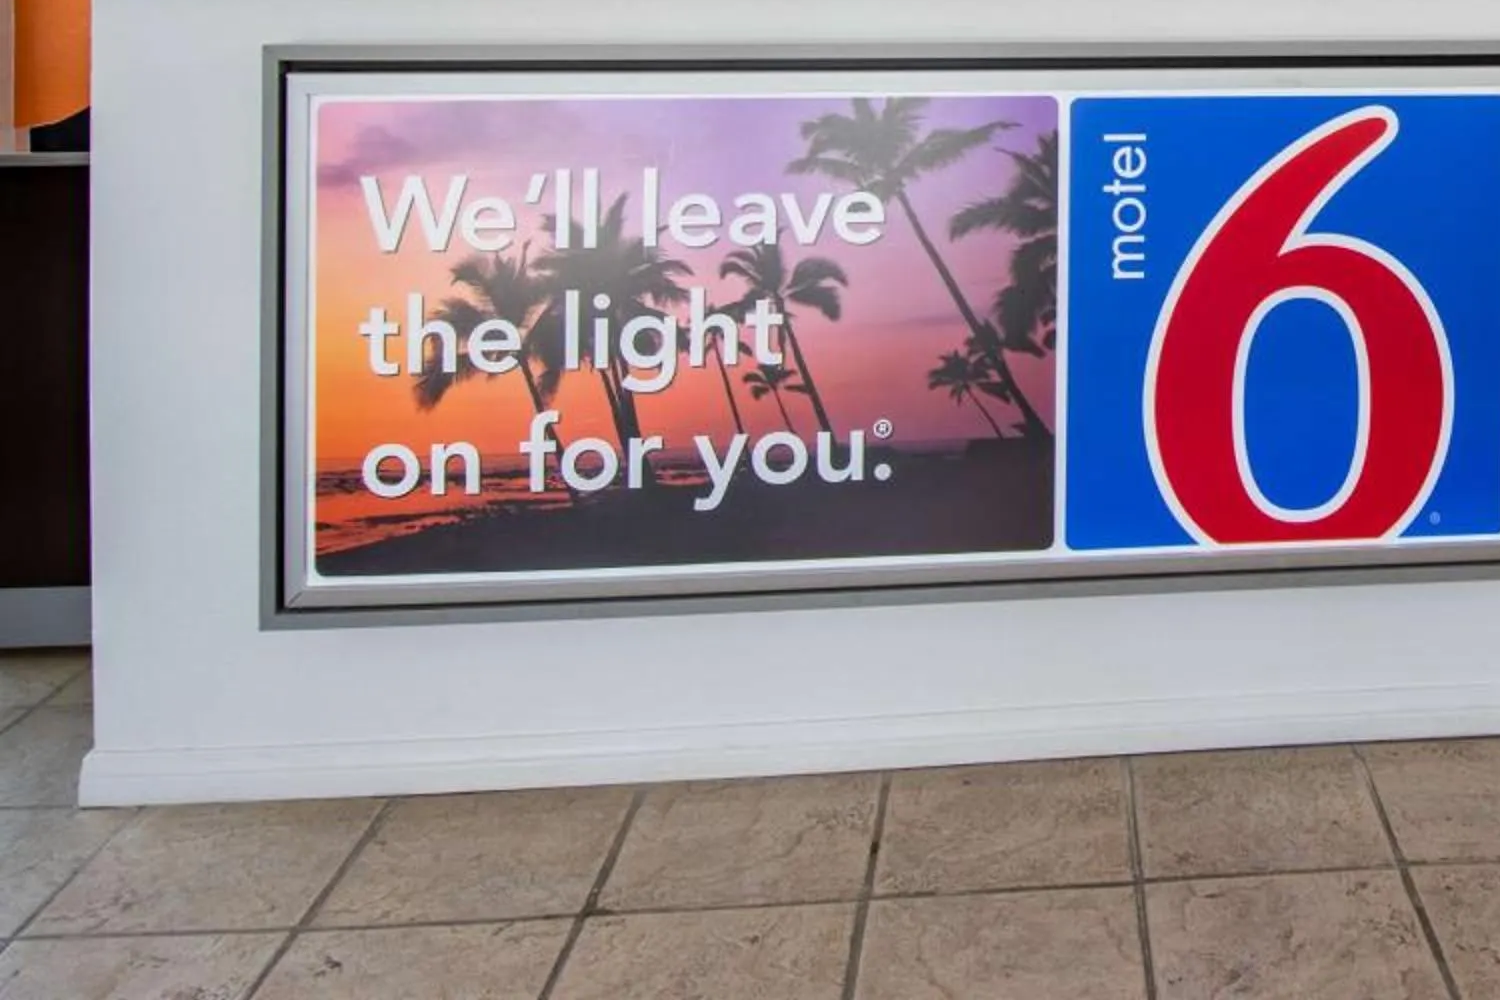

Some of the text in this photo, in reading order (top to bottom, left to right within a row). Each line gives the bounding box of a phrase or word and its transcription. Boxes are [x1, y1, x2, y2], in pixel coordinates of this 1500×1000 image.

[642, 166, 886, 250] leave
[1102, 132, 1148, 280] motel
[359, 286, 784, 394] the light
[1142, 104, 1456, 550] 6
[361, 439, 482, 498] on
[519, 410, 665, 494] for
